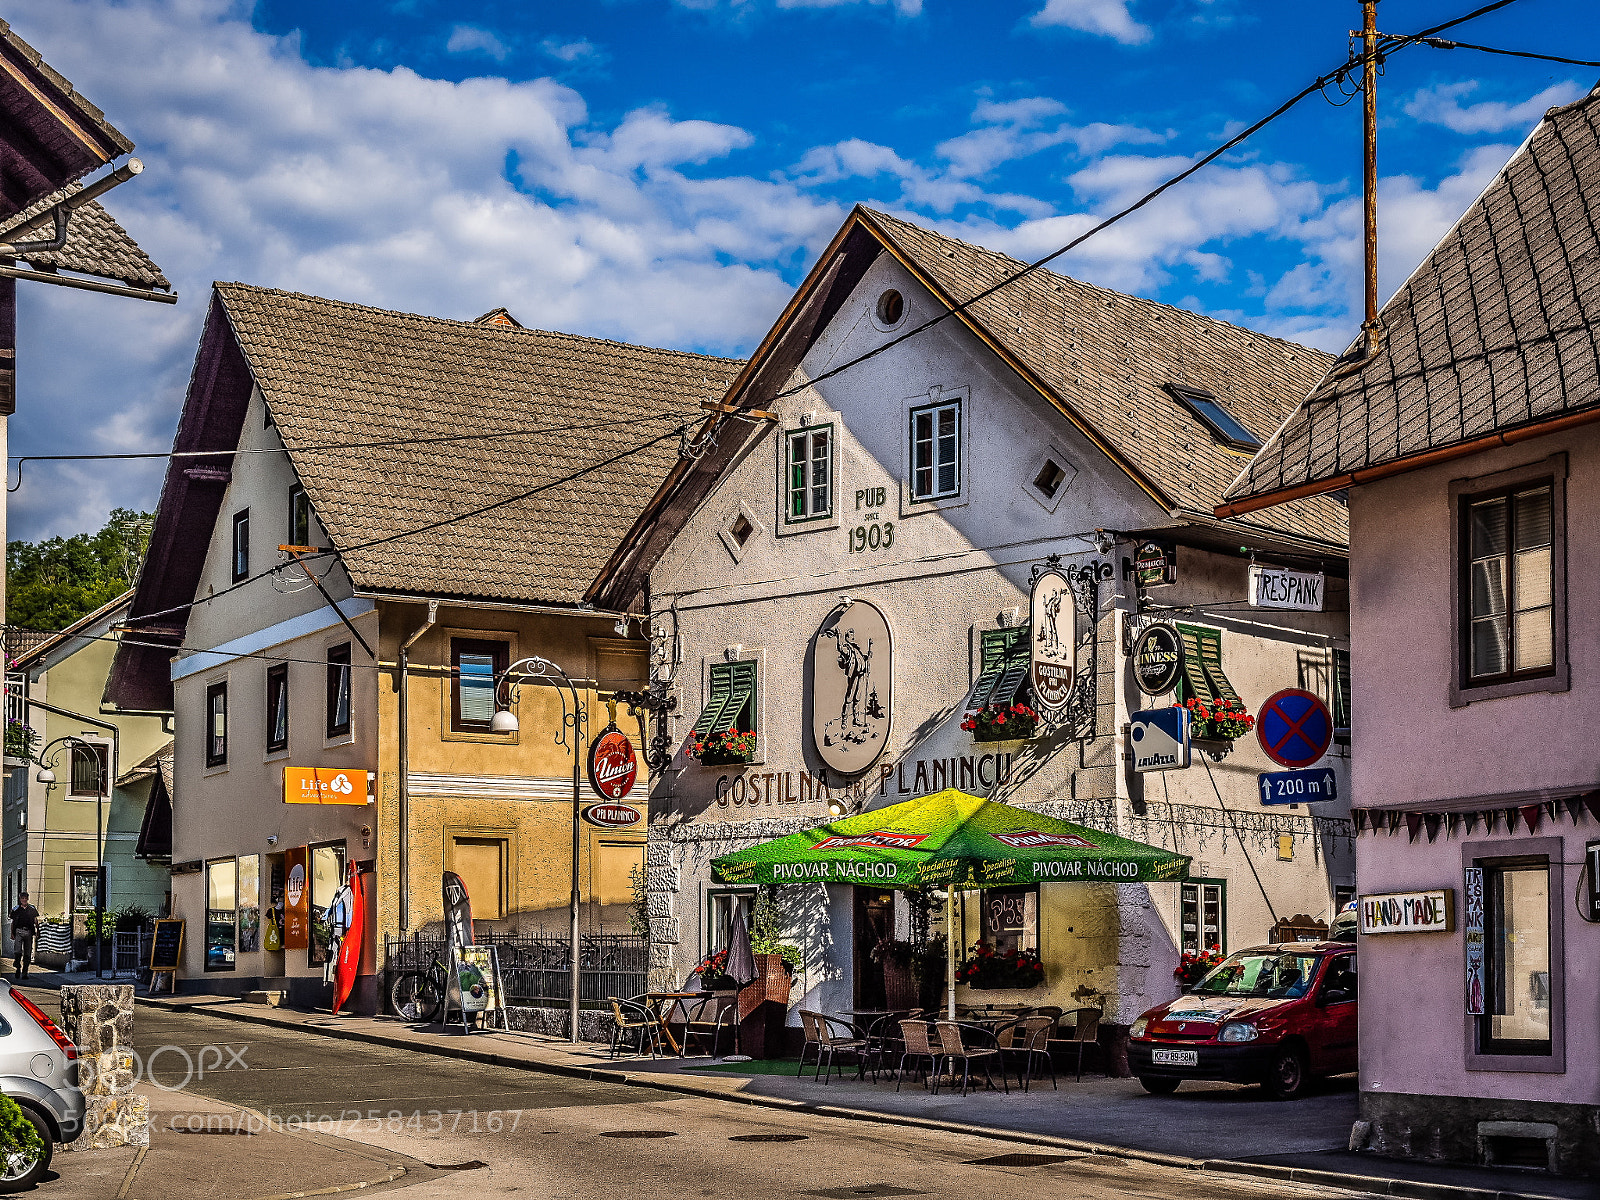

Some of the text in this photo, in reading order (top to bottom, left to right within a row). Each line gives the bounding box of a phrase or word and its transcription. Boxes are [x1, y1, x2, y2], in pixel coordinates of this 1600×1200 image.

[855, 486, 887, 511] PUB
[848, 522, 895, 554] 1903
[1254, 573, 1321, 606] TREŠPANK
[1038, 665, 1068, 680] GOSTILNA
[596, 757, 635, 780] Union
[1137, 752, 1177, 768] LAVAZZA
[301, 779, 328, 791] Life
[715, 768, 831, 809] GOSTILNA
[880, 752, 1013, 797] PLANINCU
[1276, 778, 1320, 796] 200 m
[773, 858, 897, 878] PIVOVAR NÁCHOD
[916, 858, 959, 876] Specialista
[980, 857, 1016, 875] Specialista
[1033, 860, 1081, 877] PIVOVAR
[1087, 857, 1138, 877] NÁCHOD
[1365, 896, 1445, 928] HAND MADE
[1154, 1051, 1164, 1061] KP
